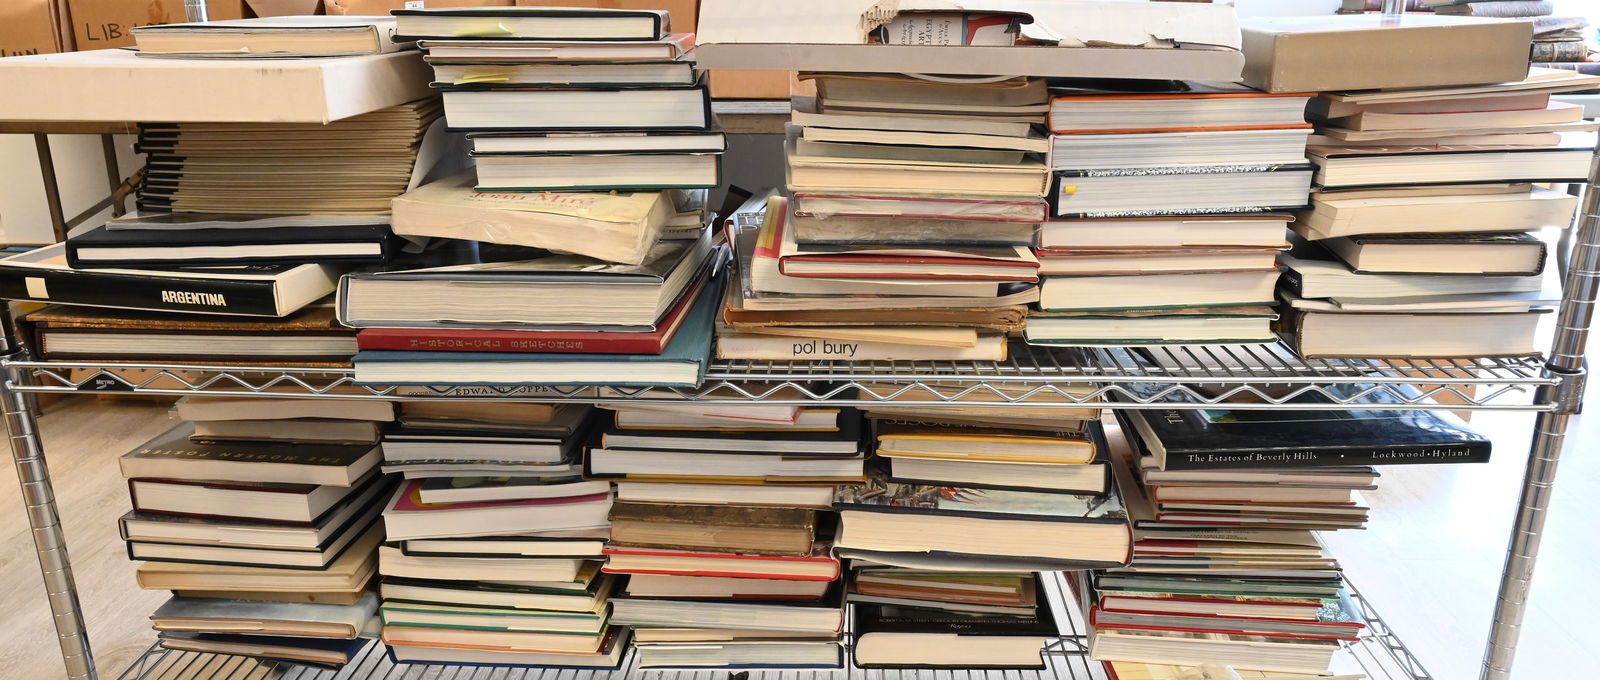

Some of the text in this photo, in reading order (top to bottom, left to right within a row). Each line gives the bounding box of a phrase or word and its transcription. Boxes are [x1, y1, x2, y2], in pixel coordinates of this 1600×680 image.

[161, 290, 227, 307] ARGENTINA
[410, 339, 584, 349] HISTORICAL SKETCHES
[793, 340, 858, 357] pol bury
[455, 386, 505, 396] EDWAD
[1188, 454, 1205, 462] The
[1208, 454, 1241, 462] Estates
[1243, 453, 1255, 462] of
[1256, 452, 1291, 463] Beverly
[1293, 451, 1317, 460] Hills
[1372, 450, 1425, 459] Lockwood
